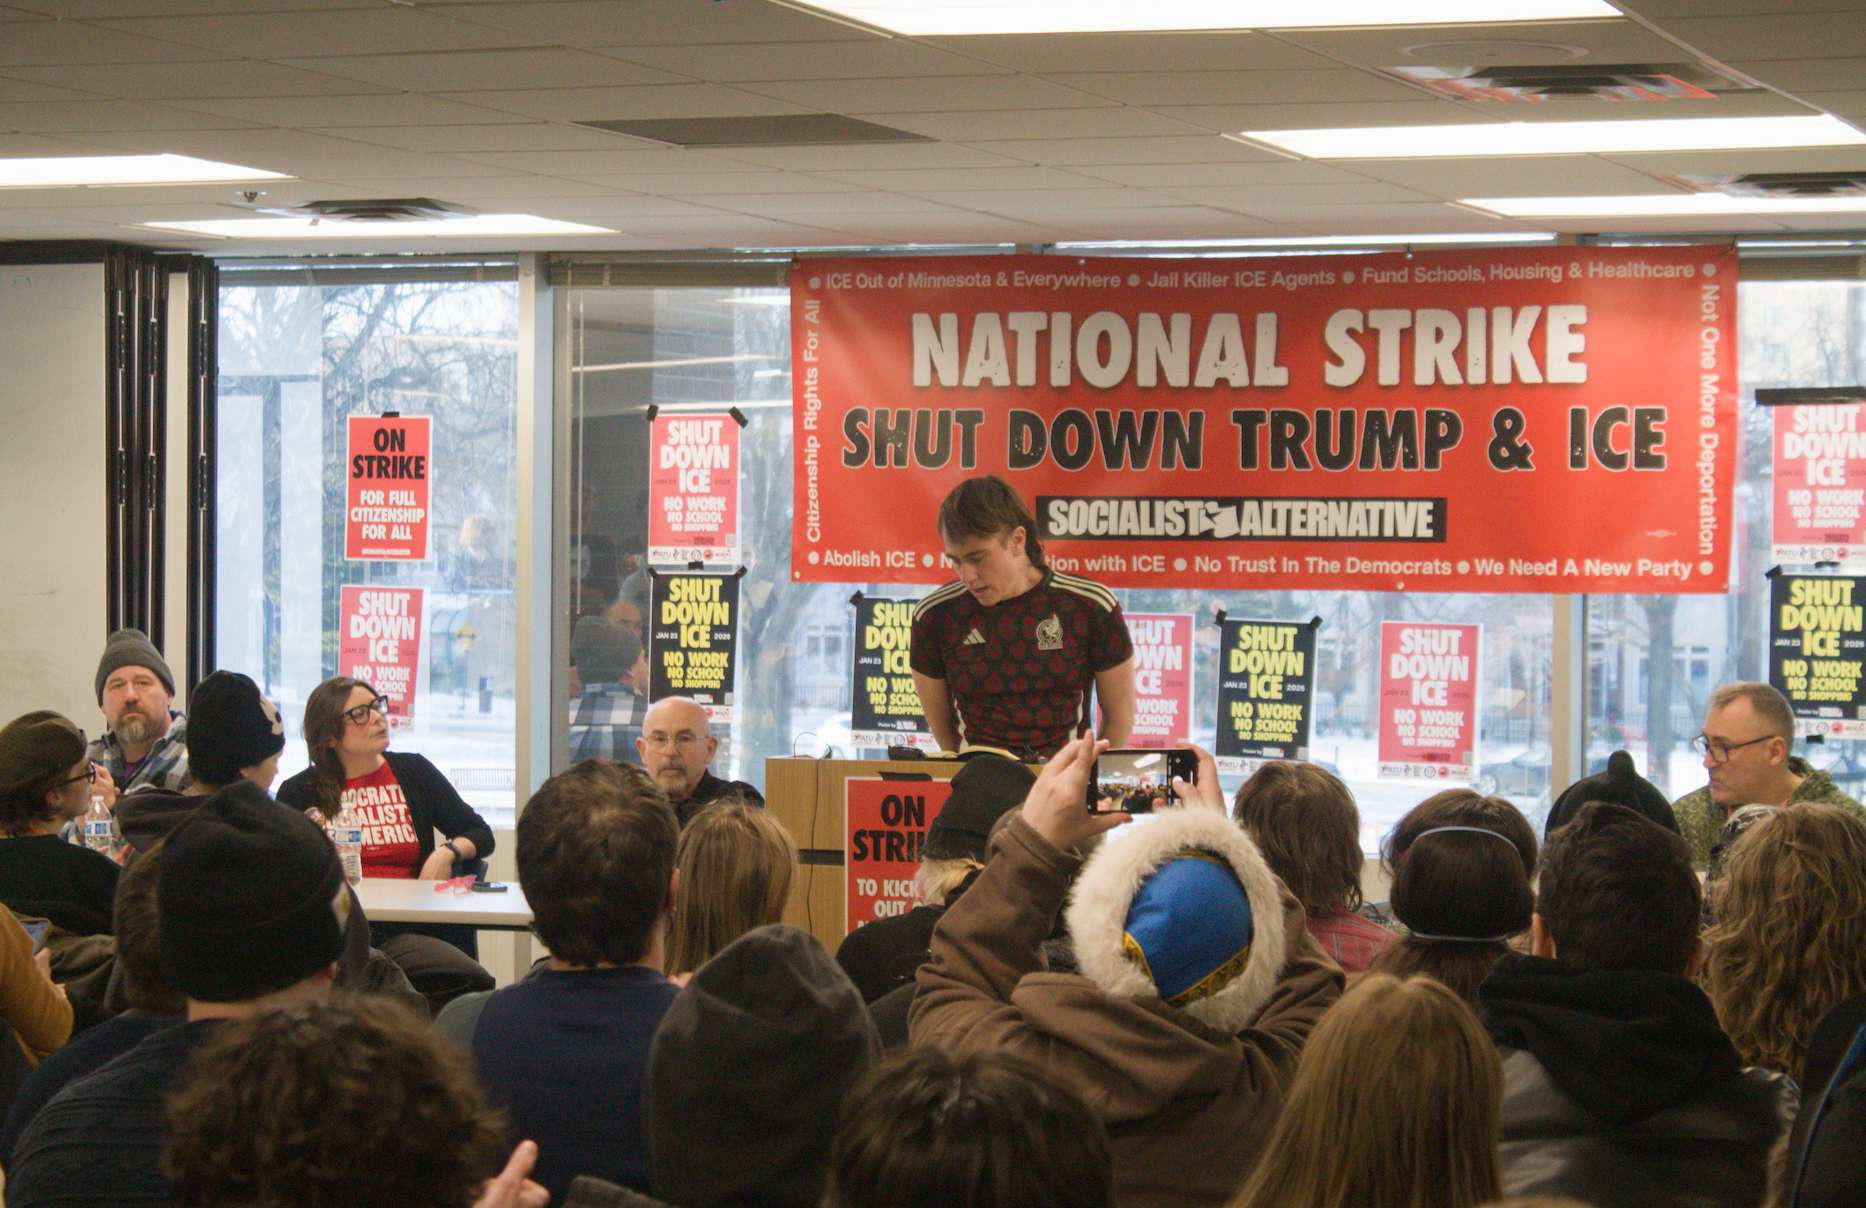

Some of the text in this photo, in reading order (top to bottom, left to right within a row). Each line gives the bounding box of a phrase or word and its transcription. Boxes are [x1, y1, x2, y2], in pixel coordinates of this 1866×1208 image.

[826, 271, 1121, 290] ICE Out of Minnesota & Everywhere
[1148, 270, 1335, 291] Jail Killer ICE Agents
[1363, 261, 1695, 284] Fund Schools, Housing & Healthcare
[912, 304, 1587, 388] NATIONAL STRIKE
[804, 300, 821, 542] Citizenship Rights For All
[1697, 285, 1720, 555] Not One More Deportation
[1793, 406, 1860, 433] SHUT
[374, 428, 405, 452] ON
[668, 420, 723, 445] SHUT
[842, 406, 1667, 471] SHUT DOWN TRUMP & ICE
[1784, 432, 1866, 459] DOWN
[353, 455, 425, 479] STRIKE
[660, 445, 729, 469] DOWN
[679, 469, 710, 493] ICE
[1807, 459, 1846, 485] ICE
[360, 490, 416, 506] FOR FULL
[664, 497, 726, 511] NO WORK
[1788, 490, 1864, 505] NO WORK
[351, 507, 425, 523] CITIZENSHIP
[668, 512, 723, 522] NO SCHOOL
[1048, 500, 1433, 537] SOCIALIST ALTERNATIVE
[1793, 506, 1861, 518] NO SCHOOL
[362, 524, 412, 540] FOR ALL
[671, 523, 718, 532] NO SHOPPING
[1798, 519, 1855, 528] NO SHOPPING
[823, 550, 915, 567] Abolish ICE
[1085, 555, 1126, 572] with
[1133, 556, 1165, 572] ICE
[1195, 556, 1452, 575] No Trust In The Democrats
[1475, 558, 1693, 581] We Need A New Party
[669, 578, 722, 602] SHUT
[1790, 580, 1855, 606] SHUT
[359, 591, 410, 616] SHUT
[662, 601, 729, 625] DOWN
[873, 602, 913, 627] SHU
[1782, 604, 1862, 632] DOWN
[351, 614, 415, 640] DOWN
[680, 625, 710, 648] ICE
[1126, 619, 1175, 645] HUT
[865, 626, 911, 650] DOW
[1239, 625, 1298, 651] SHUT
[1400, 628, 1462, 655] SHUT
[1803, 631, 1840, 656] ICE
[369, 639, 399, 663] ICE
[664, 651, 729, 667] NO WORK
[353, 665, 410, 681] NO WORK
[1230, 649, 1304, 676] DOWN
[1391, 654, 1469, 681] DOWN
[1784, 660, 1862, 678] NO WORK
[668, 667, 725, 680] NO SCHOOL
[1135, 670, 1162, 695] CE
[1788, 677, 1858, 691] NO SCHOOL
[375, 680, 407, 693] SCHOOL
[671, 680, 720, 689] NO SHOPPING
[867, 677, 887, 692] NO
[1250, 675, 1283, 699] ICE
[1412, 680, 1448, 706] ICE
[870, 693, 887, 705] NO
[1136, 699, 1178, 714] WORK
[1793, 691, 1852, 701] NO SHOPPING
[874, 705, 886, 714] NO
[1134, 714, 1174, 726] SCHOOL
[1231, 702, 1302, 720] NO WORK
[1394, 709, 1464, 726] NO WORK
[1133, 726, 1170, 735] SHOPPING
[1235, 718, 1298, 733] NO SCHOOL
[1398, 725, 1460, 739] NO SCHOOL
[1239, 731, 1292, 742] NO SHOPPING
[1403, 737, 1455, 748] NO SHOPPING
[881, 795, 925, 826] ON
[857, 878, 920, 897] TO KICK
[874, 900, 906, 917] OUT
